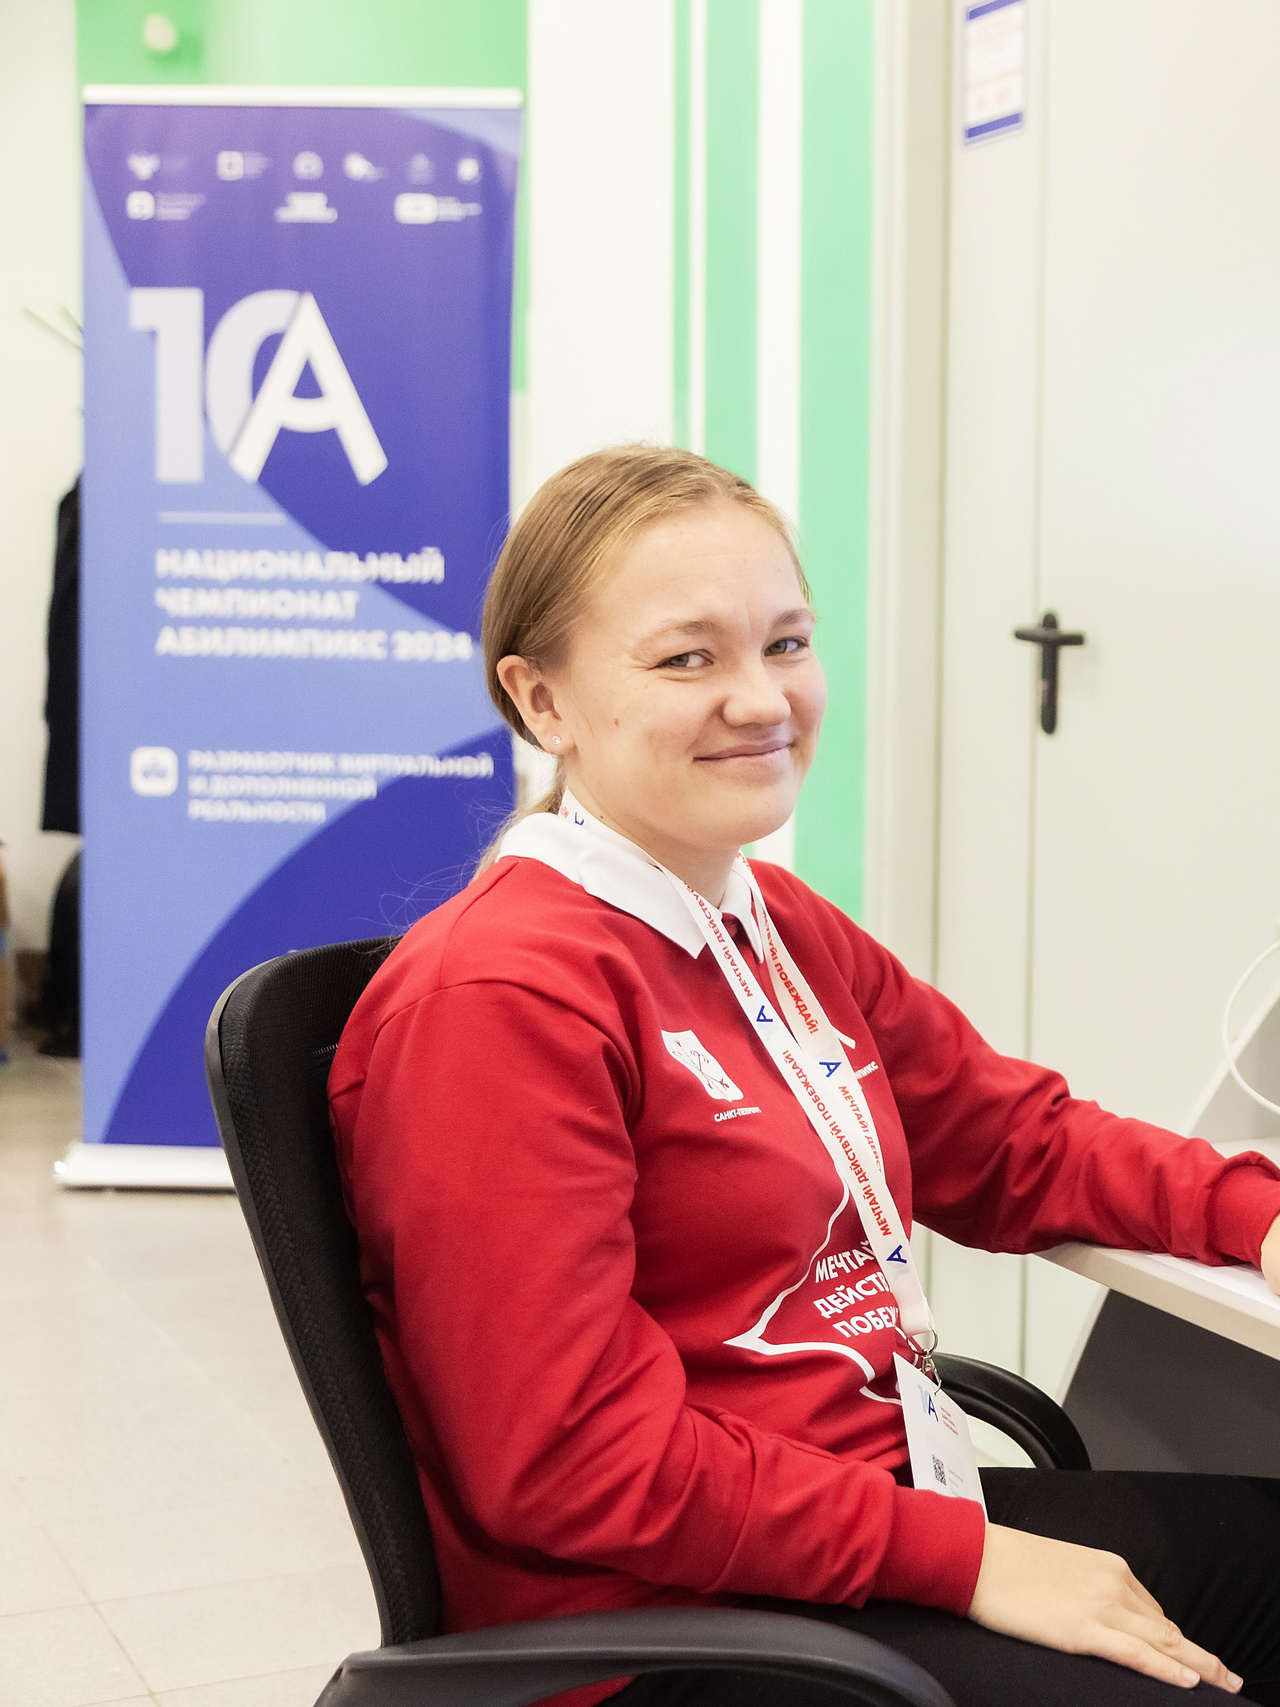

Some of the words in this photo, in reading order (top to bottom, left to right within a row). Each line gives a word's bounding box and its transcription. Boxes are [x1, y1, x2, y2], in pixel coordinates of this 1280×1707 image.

[155, 546, 445, 584] НАЦИОНАЛЬНЫЙ
[155, 587, 360, 620] ЧЕМПИОНАТ
[155, 626, 388, 659] АБИЛИМПИКС
[391, 630, 474, 662] 2024
[188, 750, 334, 773] РАЗРАБОТЧИК
[337, 752, 494, 779] ВИРТУАЛЬНОЙ
[188, 774, 209, 798] И
[209, 774, 378, 800] ДОПОЛНЕННОЙ
[188, 799, 327, 823] РЕАЛЬНОСТИ
[685, 884, 726, 943] ДЕЙСТВУ
[722, 946, 753, 998] МЕЧТАЙ!
[774, 962, 819, 1035] ПОБЕЖДАЙ!
[782, 1049, 833, 1121] ПОБЕЖДАЙ!
[838, 1086, 870, 1133] МЕЧТАЙ!
[829, 1120, 870, 1184] ДЕЙСТВУЙ!
[862, 1184, 893, 1237] МЕЧТАЙ!
